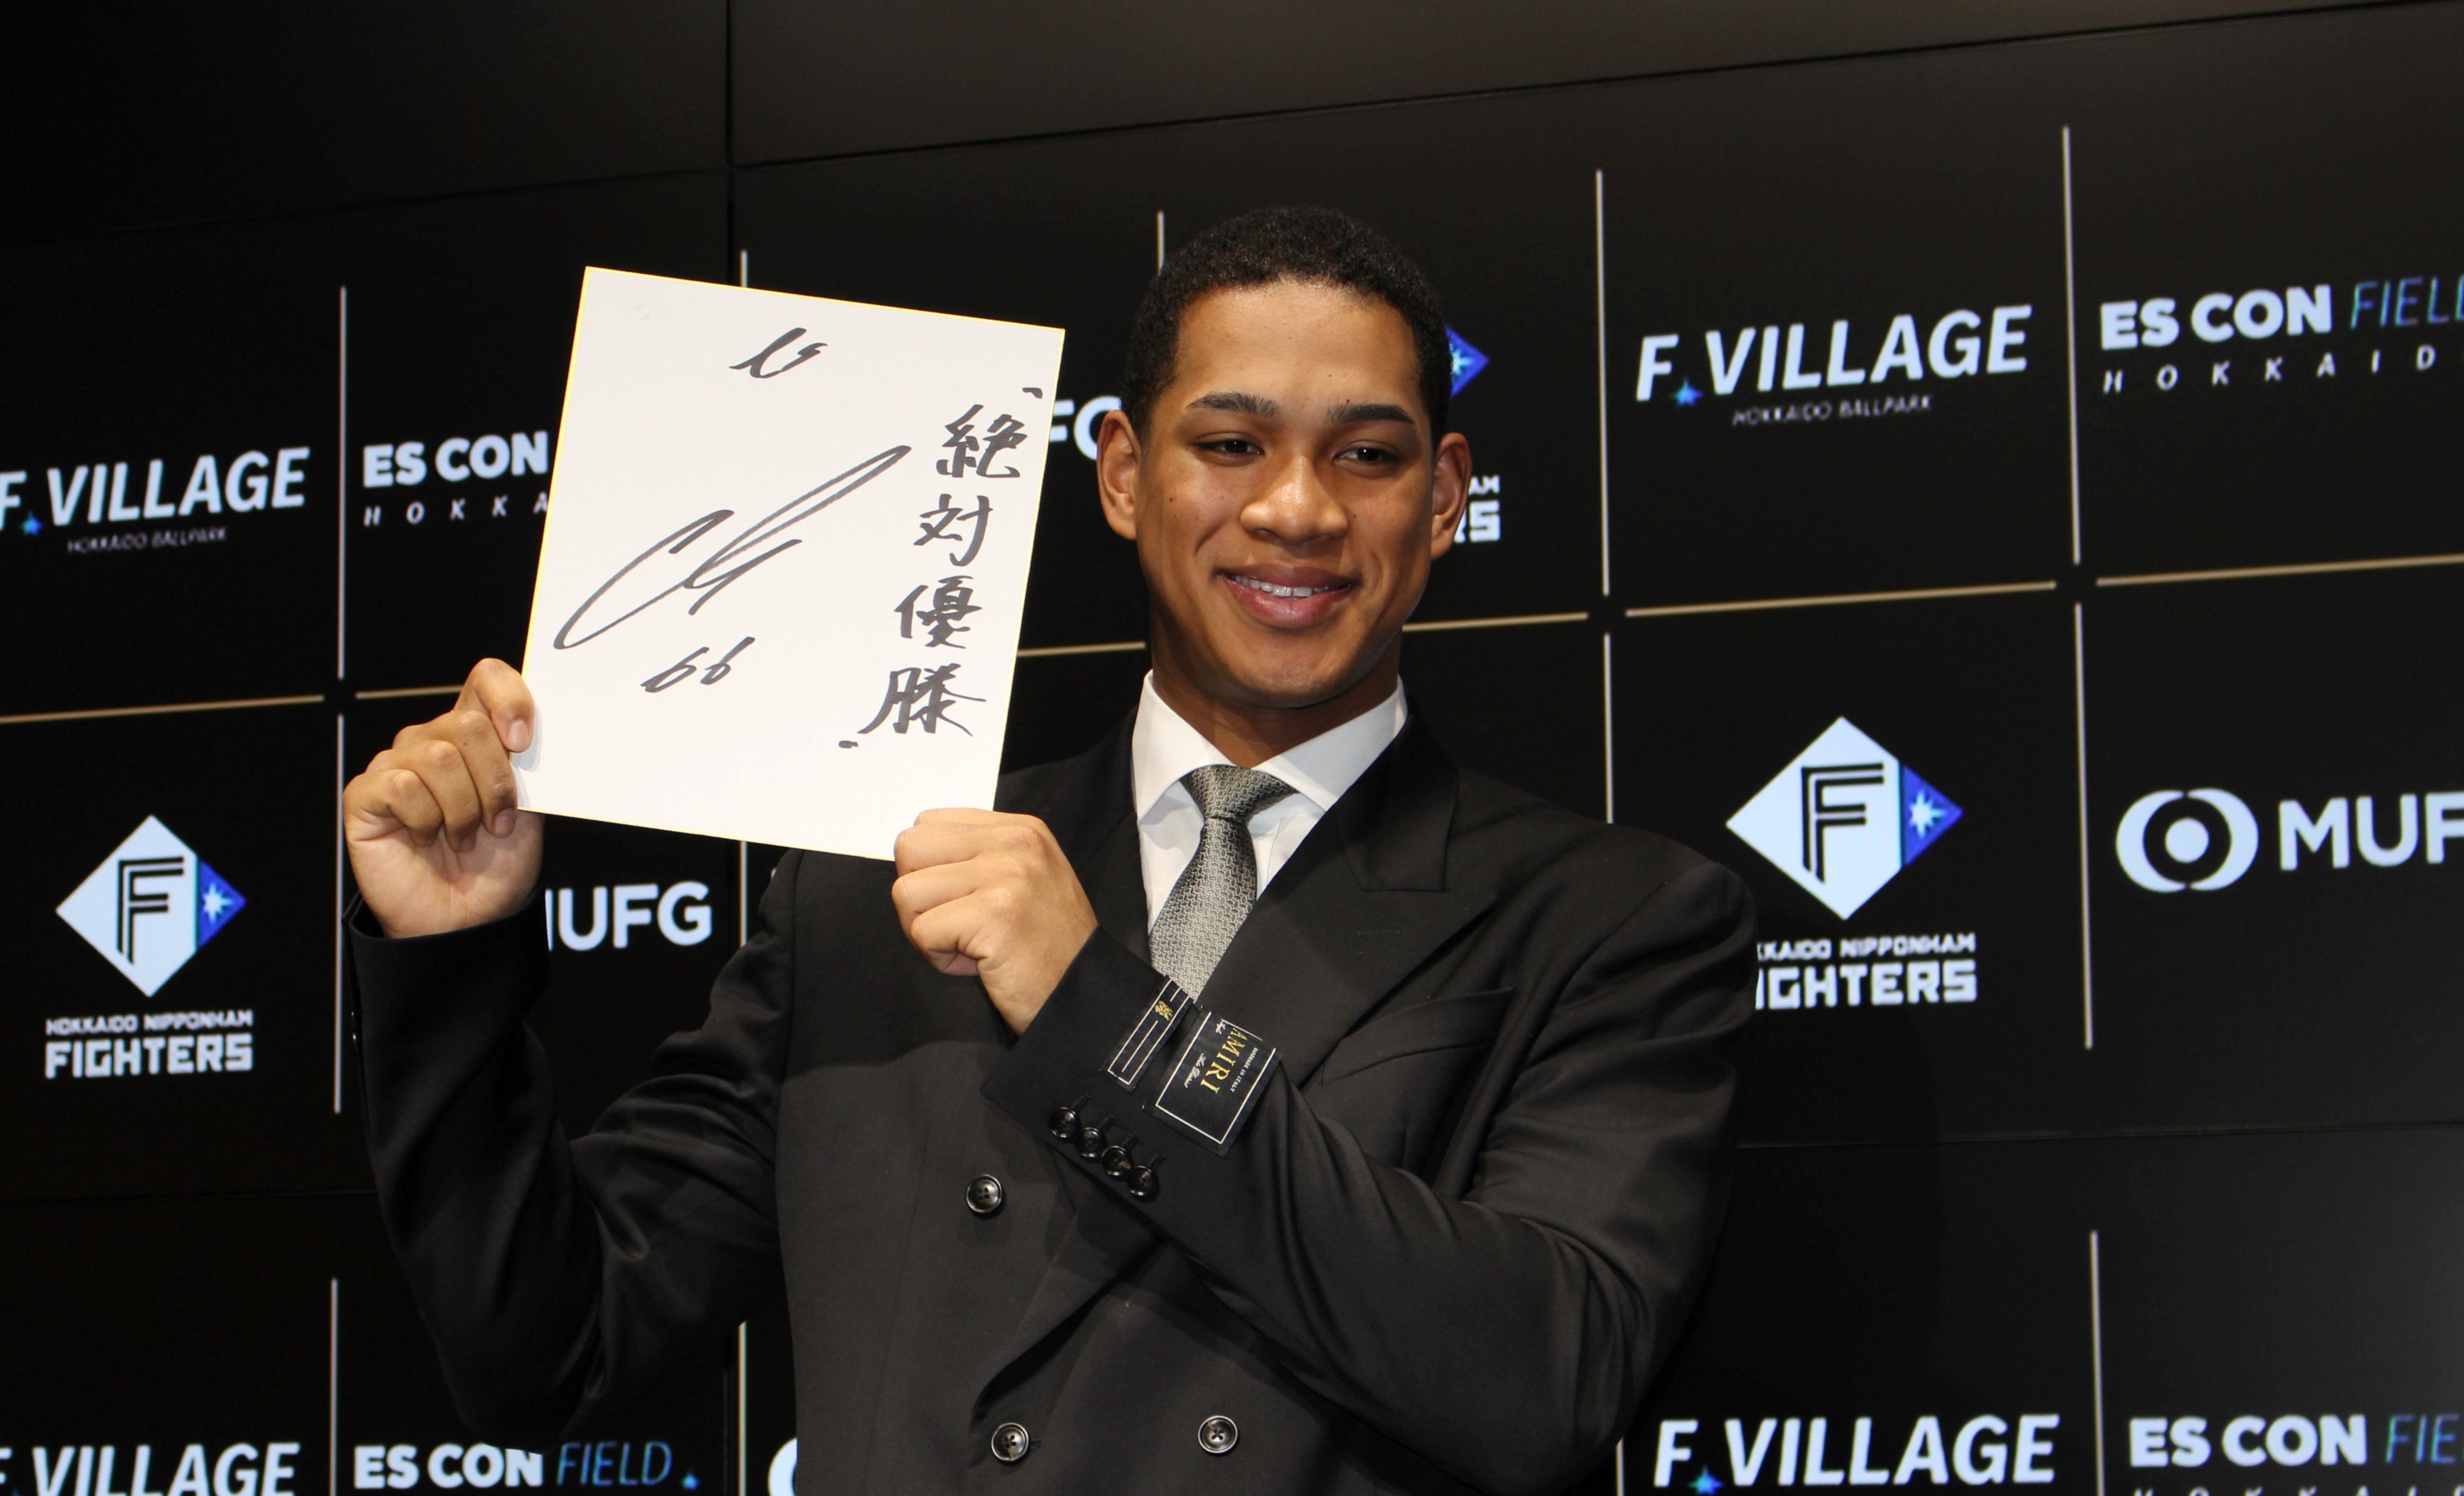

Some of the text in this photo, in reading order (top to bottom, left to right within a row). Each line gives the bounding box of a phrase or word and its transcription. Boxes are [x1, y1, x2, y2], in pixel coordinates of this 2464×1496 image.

[2100, 275, 2464, 350] ES CON FIEL
[1636, 305, 2033, 401] F VILLAGE
[1734, 396, 1931, 424] HOKKAIDO BALLPARK
[364, 431, 548, 487] ES CON
[47, 447, 310, 526] VILLAGE
[545, 881, 712, 951] UFG
[1840, 933, 1977, 957] NIPPONHAM
[1755, 959, 1978, 1010] IGHTERS
[46, 1010, 253, 1035] HOKKAIDO NIPPONHAM
[45, 1033, 253, 1079] FIGHTERS
[1200, 1028, 1248, 1094] AMIRI
[1229, 1075, 1242, 1093] ITALY
[355, 1442, 672, 1489] ES CON FIELD
[1654, 1414, 2061, 1487] F VILLAGE
[2129, 1414, 2464, 1467] ES CON FIE
[33, 1442, 300, 1496] VILLAGE
